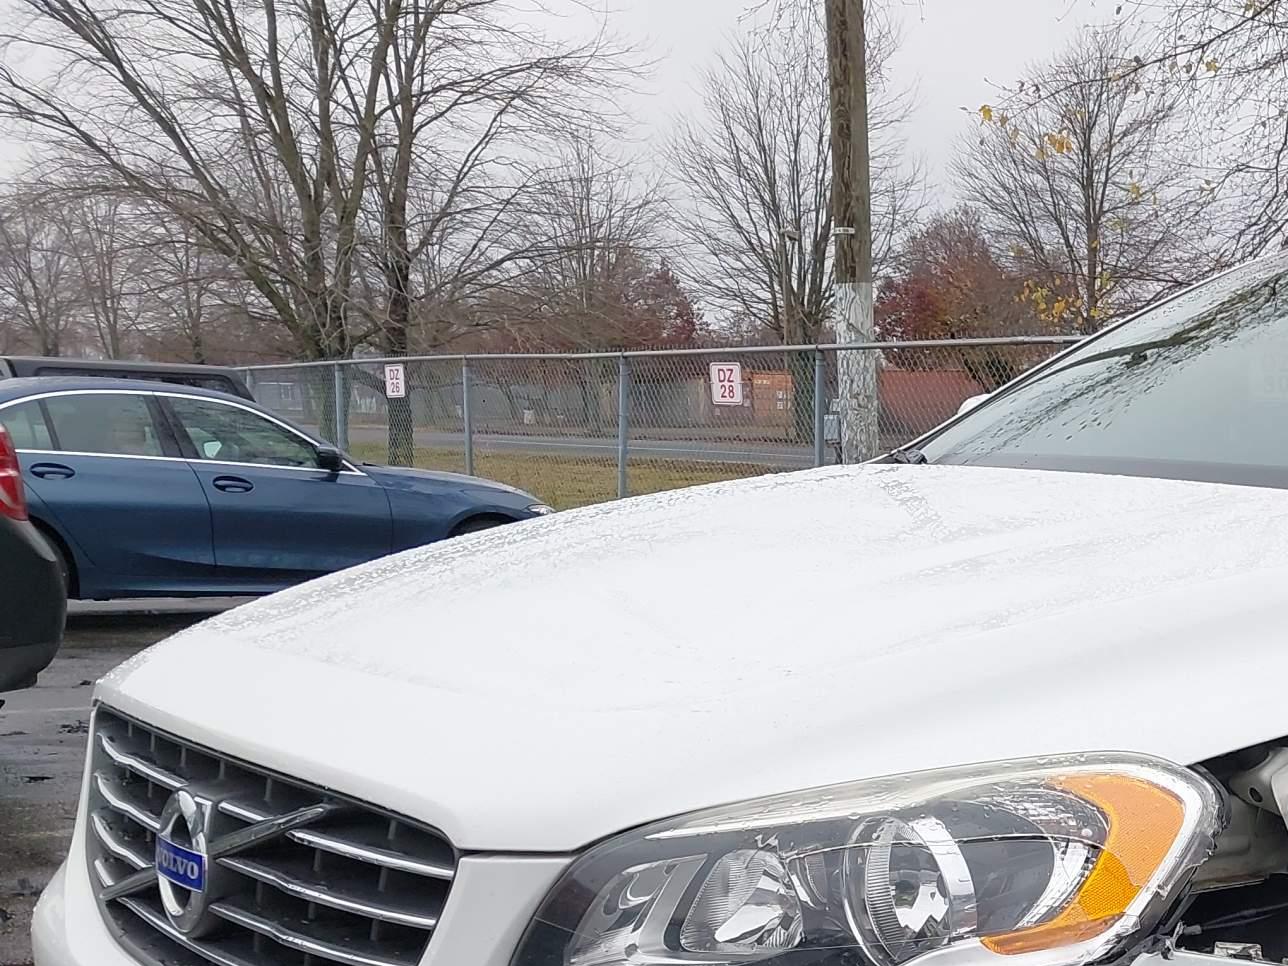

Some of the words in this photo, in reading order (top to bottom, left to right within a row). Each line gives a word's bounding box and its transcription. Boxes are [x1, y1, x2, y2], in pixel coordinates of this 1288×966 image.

[389, 368, 400, 380] DZ
[717, 368, 735, 383] DZ
[390, 382, 401, 393] 26
[720, 384, 735, 399] 28
[155, 846, 200, 880] VOLVO
